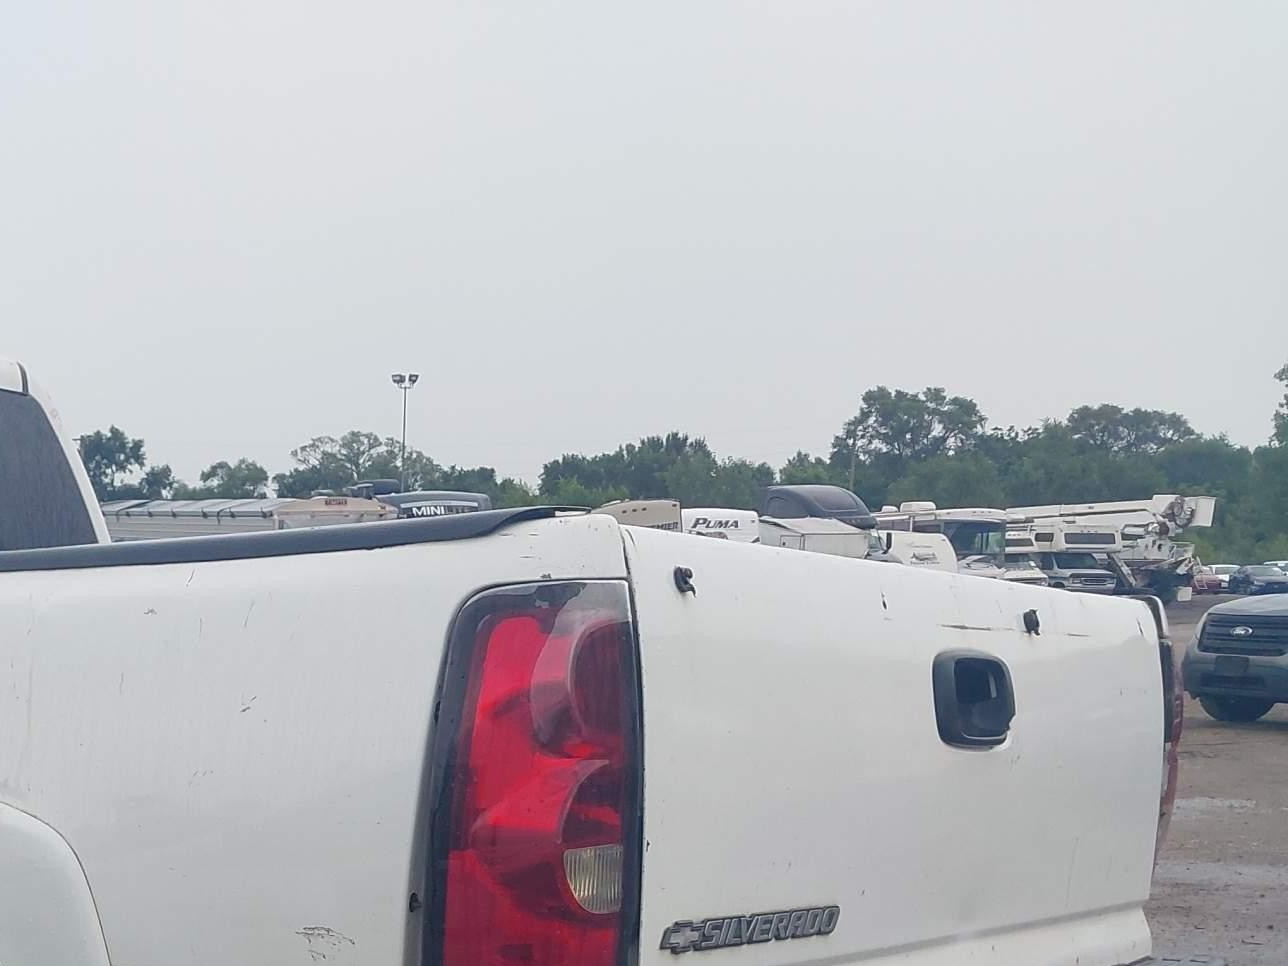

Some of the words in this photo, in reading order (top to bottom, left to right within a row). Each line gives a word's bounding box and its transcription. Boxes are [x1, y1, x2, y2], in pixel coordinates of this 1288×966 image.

[412, 505, 445, 517] MINI
[691, 517, 740, 529] PUMA
[701, 905, 841, 950] SILVERADO
